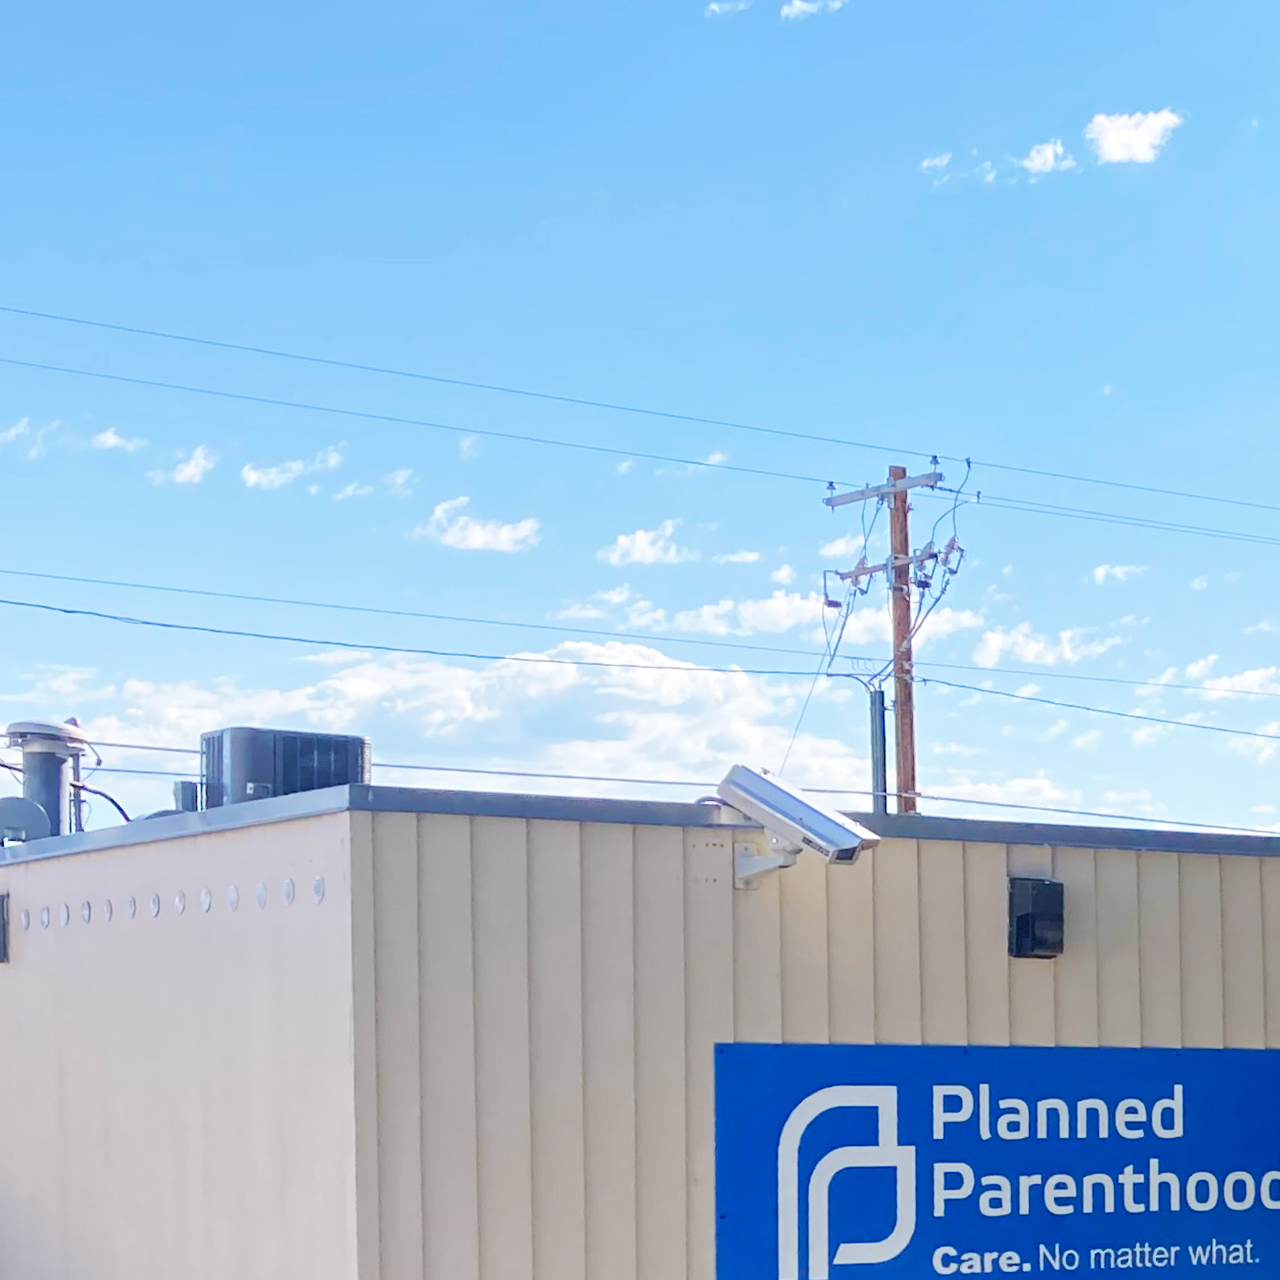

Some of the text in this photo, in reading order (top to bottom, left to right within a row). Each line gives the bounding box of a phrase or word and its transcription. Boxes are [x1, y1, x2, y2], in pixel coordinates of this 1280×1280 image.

[932, 1083, 1184, 1140] Planned
[932, 1238, 1261, 1275] Care. No matter what.
